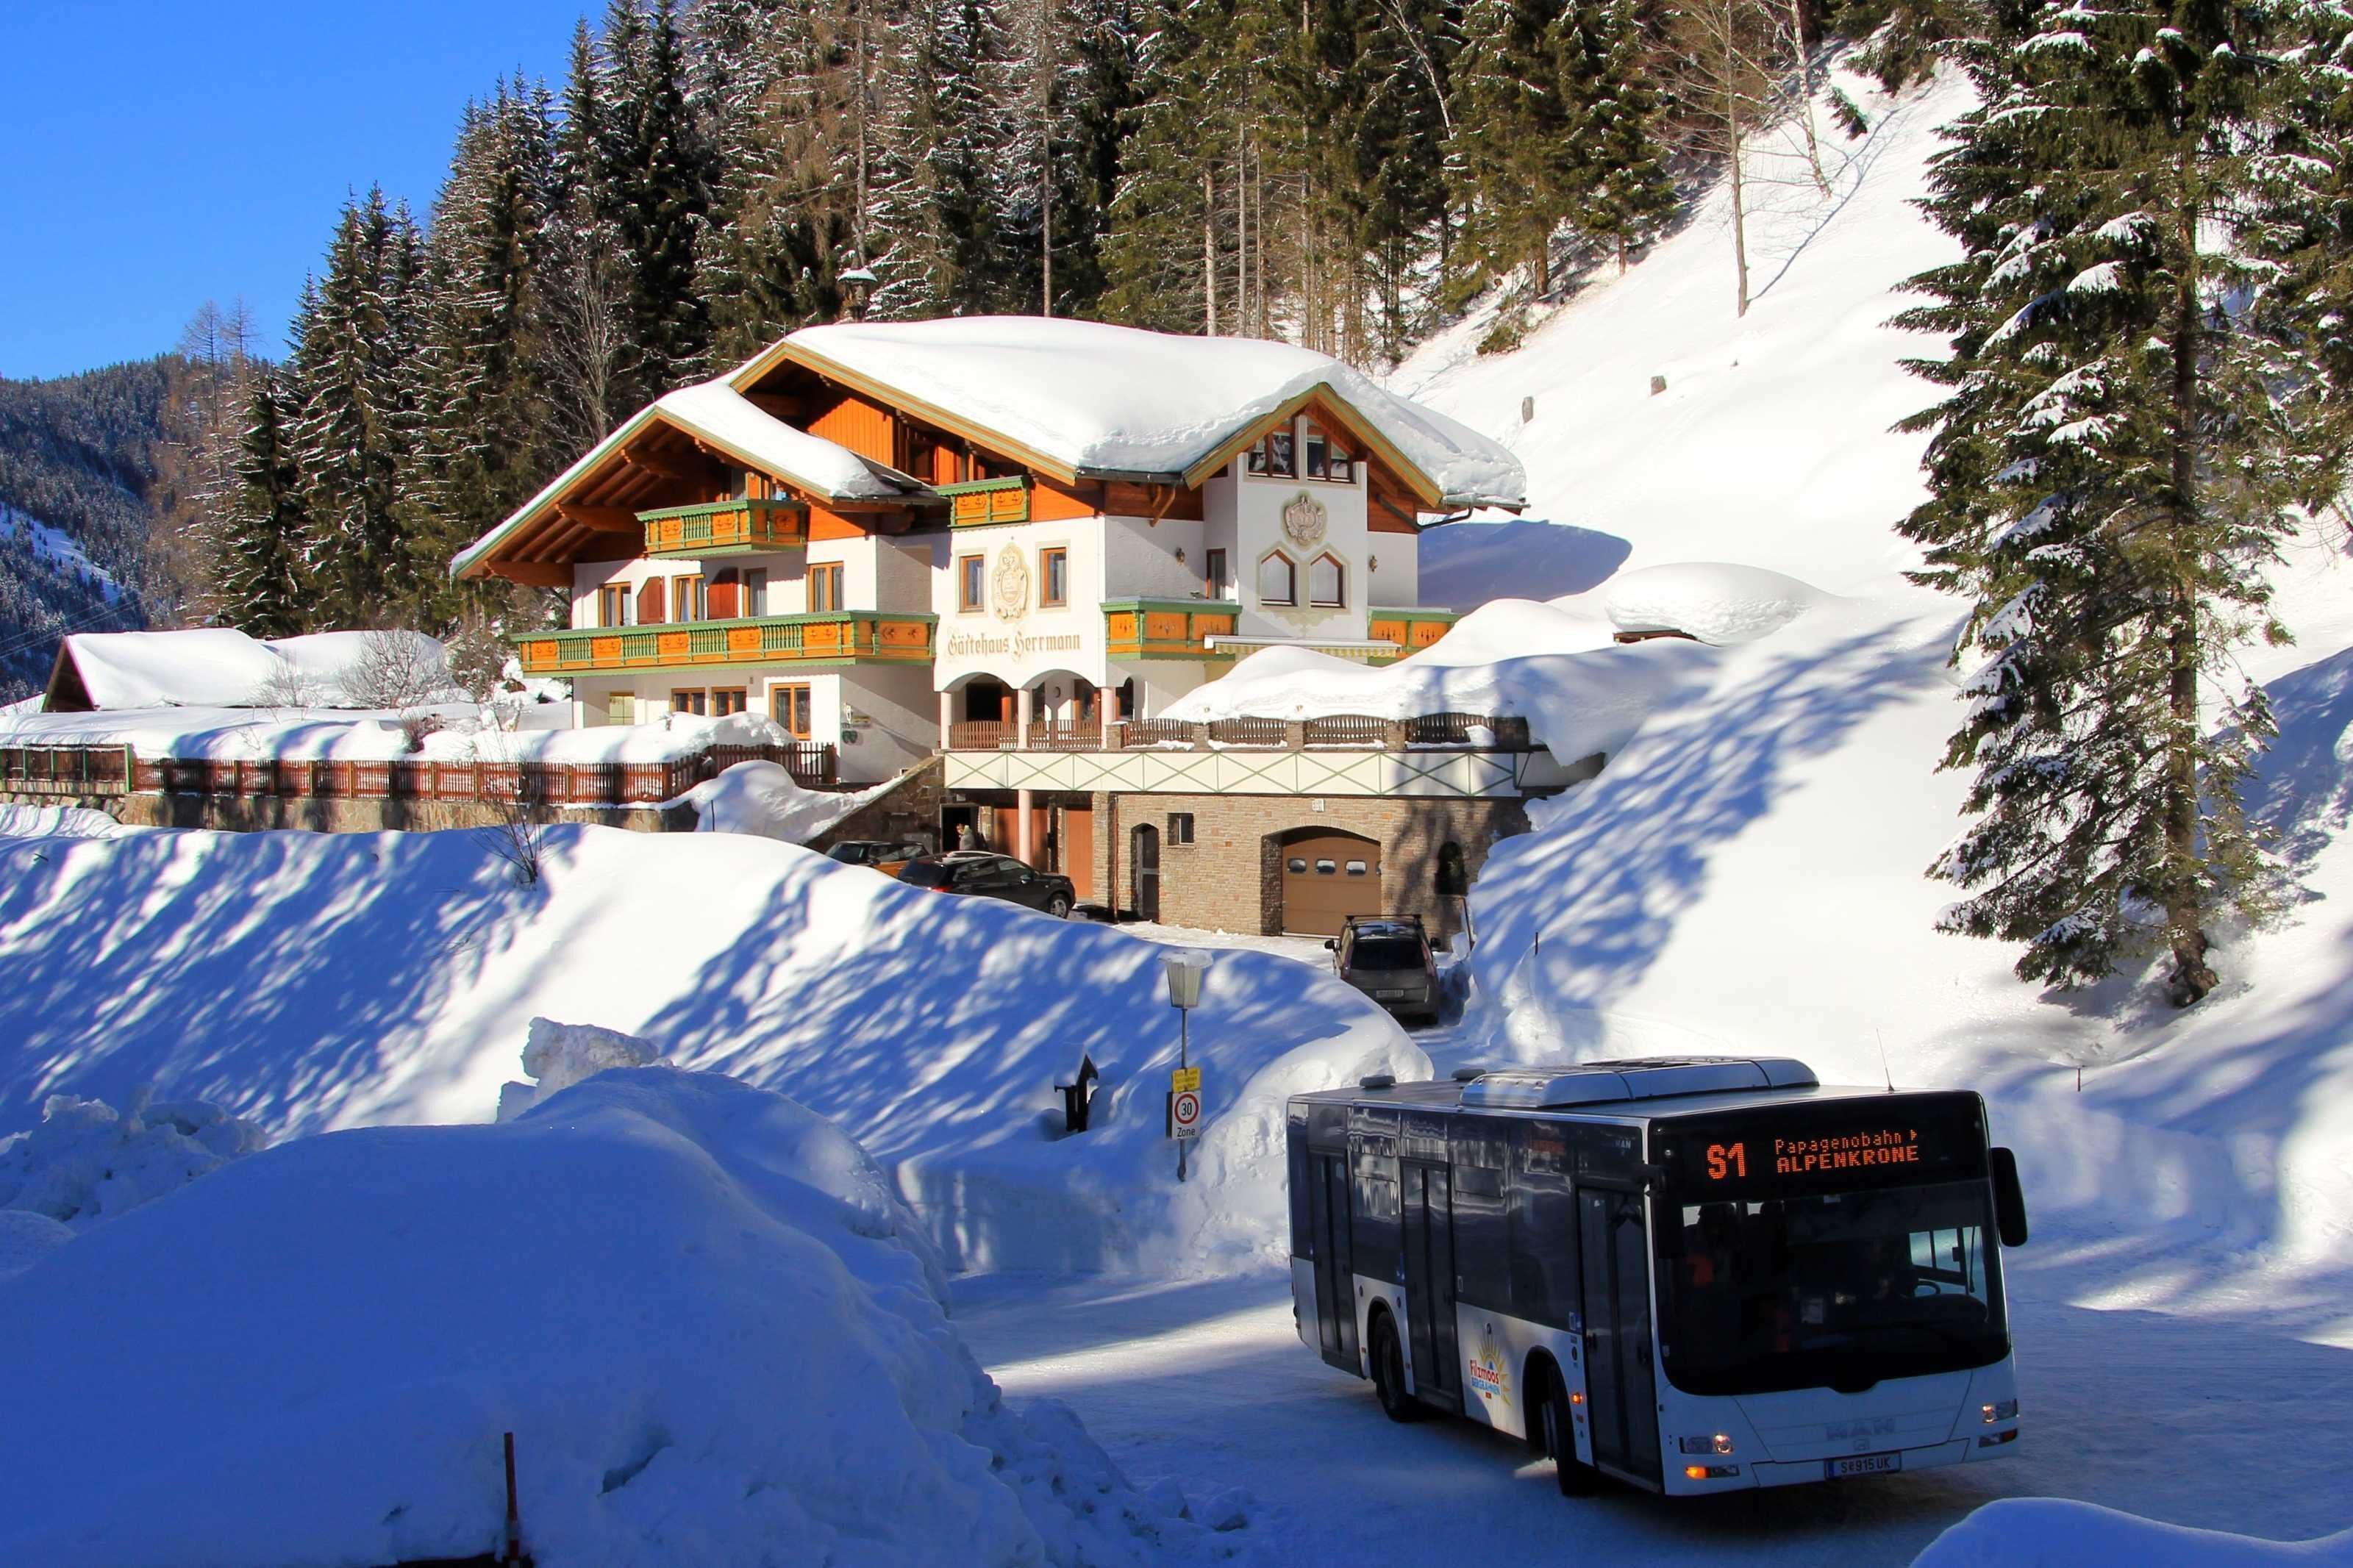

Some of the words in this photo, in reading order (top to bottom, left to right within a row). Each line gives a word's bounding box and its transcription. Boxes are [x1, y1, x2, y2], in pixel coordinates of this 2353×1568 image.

[1014, 631, 1081, 656] Herrmann
[1182, 1102, 1192, 1116] 30
[1177, 1127, 1196, 1137] Zone
[1775, 1131, 1902, 1155] Papagenobahn
[1707, 1142, 1746, 1179] S1
[1777, 1145, 1919, 1173] ALPENKRONE
[1470, 1359, 1499, 1384] Filzmoos
